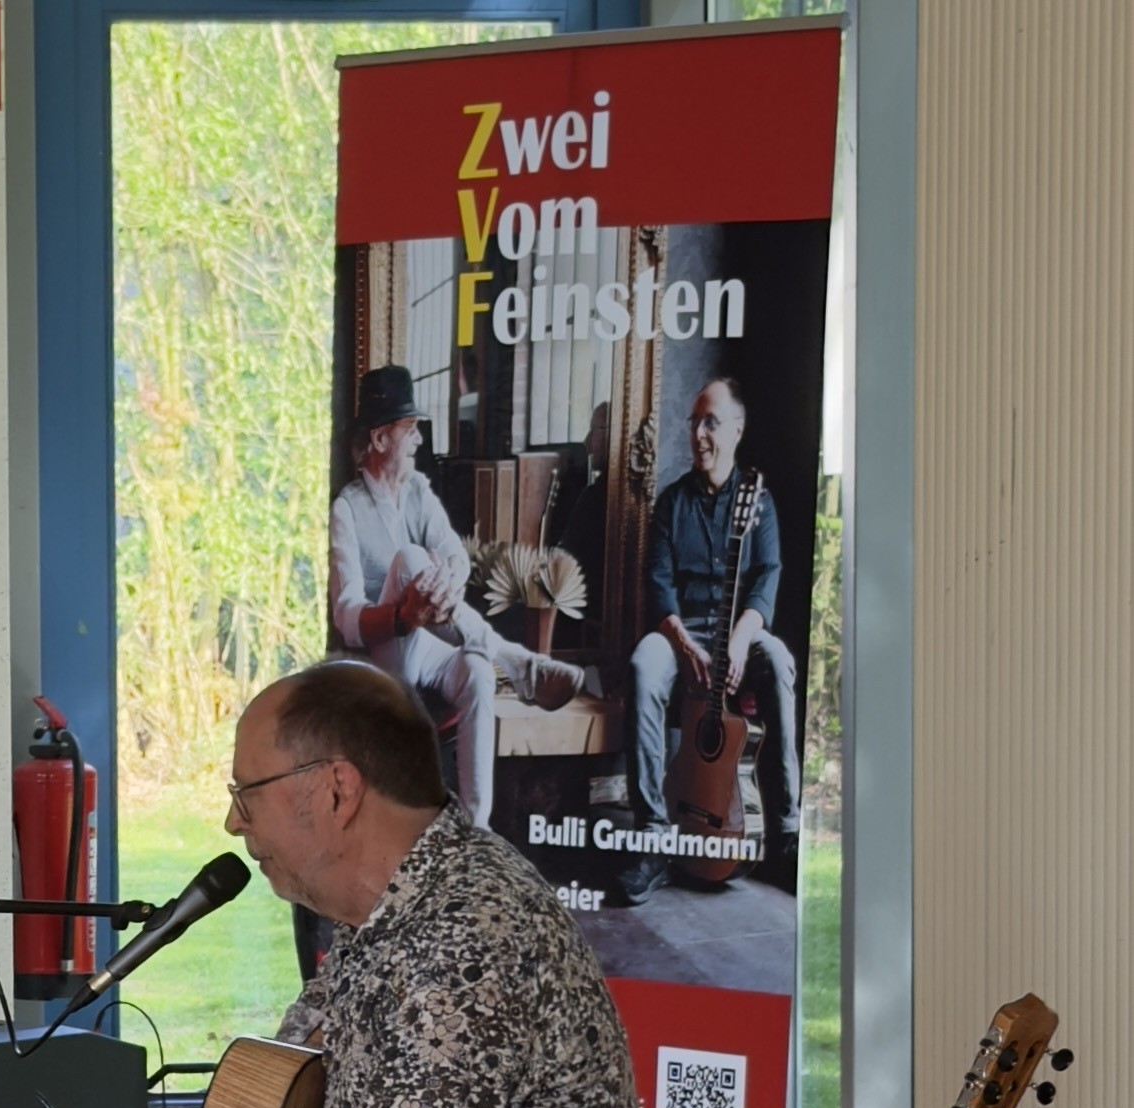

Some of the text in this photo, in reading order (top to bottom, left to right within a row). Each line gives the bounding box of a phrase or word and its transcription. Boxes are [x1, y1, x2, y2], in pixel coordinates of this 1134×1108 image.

[458, 90, 611, 180] Zwei
[457, 187, 598, 263] Vom
[457, 265, 746, 347] Feinsten
[528, 814, 756, 861] Bulli Grundmann
[557, 880, 605, 911] eier
